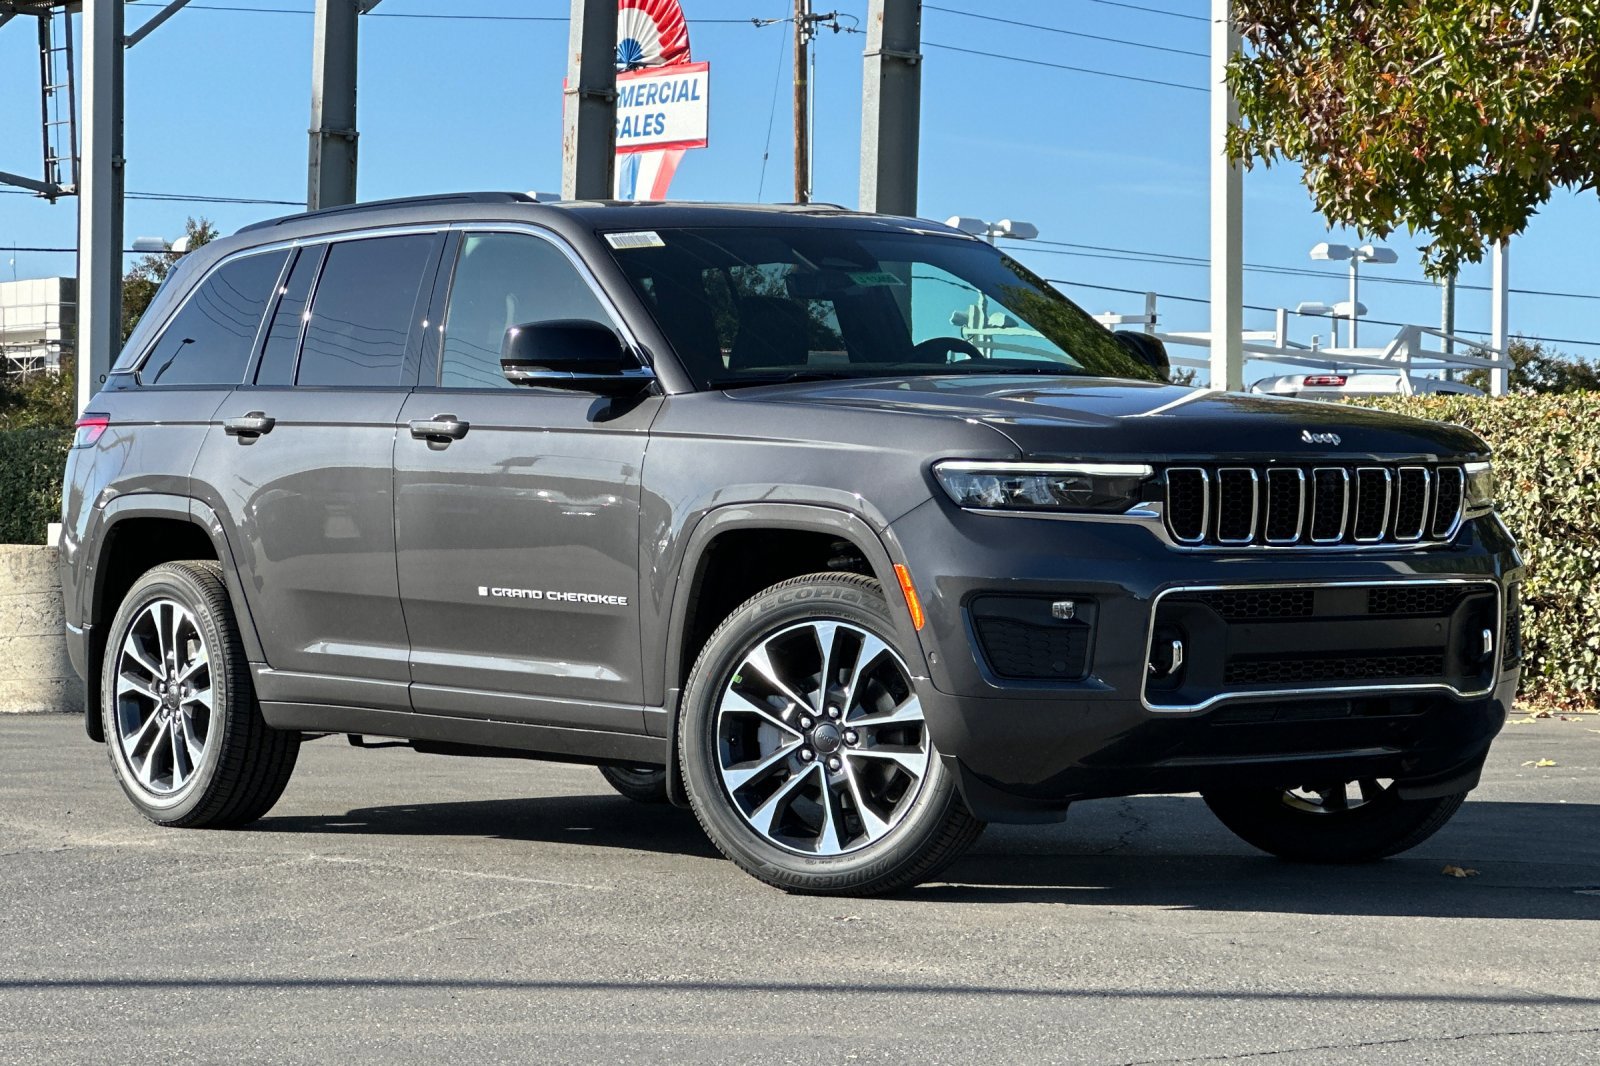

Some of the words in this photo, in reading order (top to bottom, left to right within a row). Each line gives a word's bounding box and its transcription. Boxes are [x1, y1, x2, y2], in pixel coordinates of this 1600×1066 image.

[617, 79, 701, 109] MERCIAL
[1301, 429, 1342, 446] Jeep
[491, 587, 543, 600] GRAND
[546, 591, 629, 606] CHEROKEE
